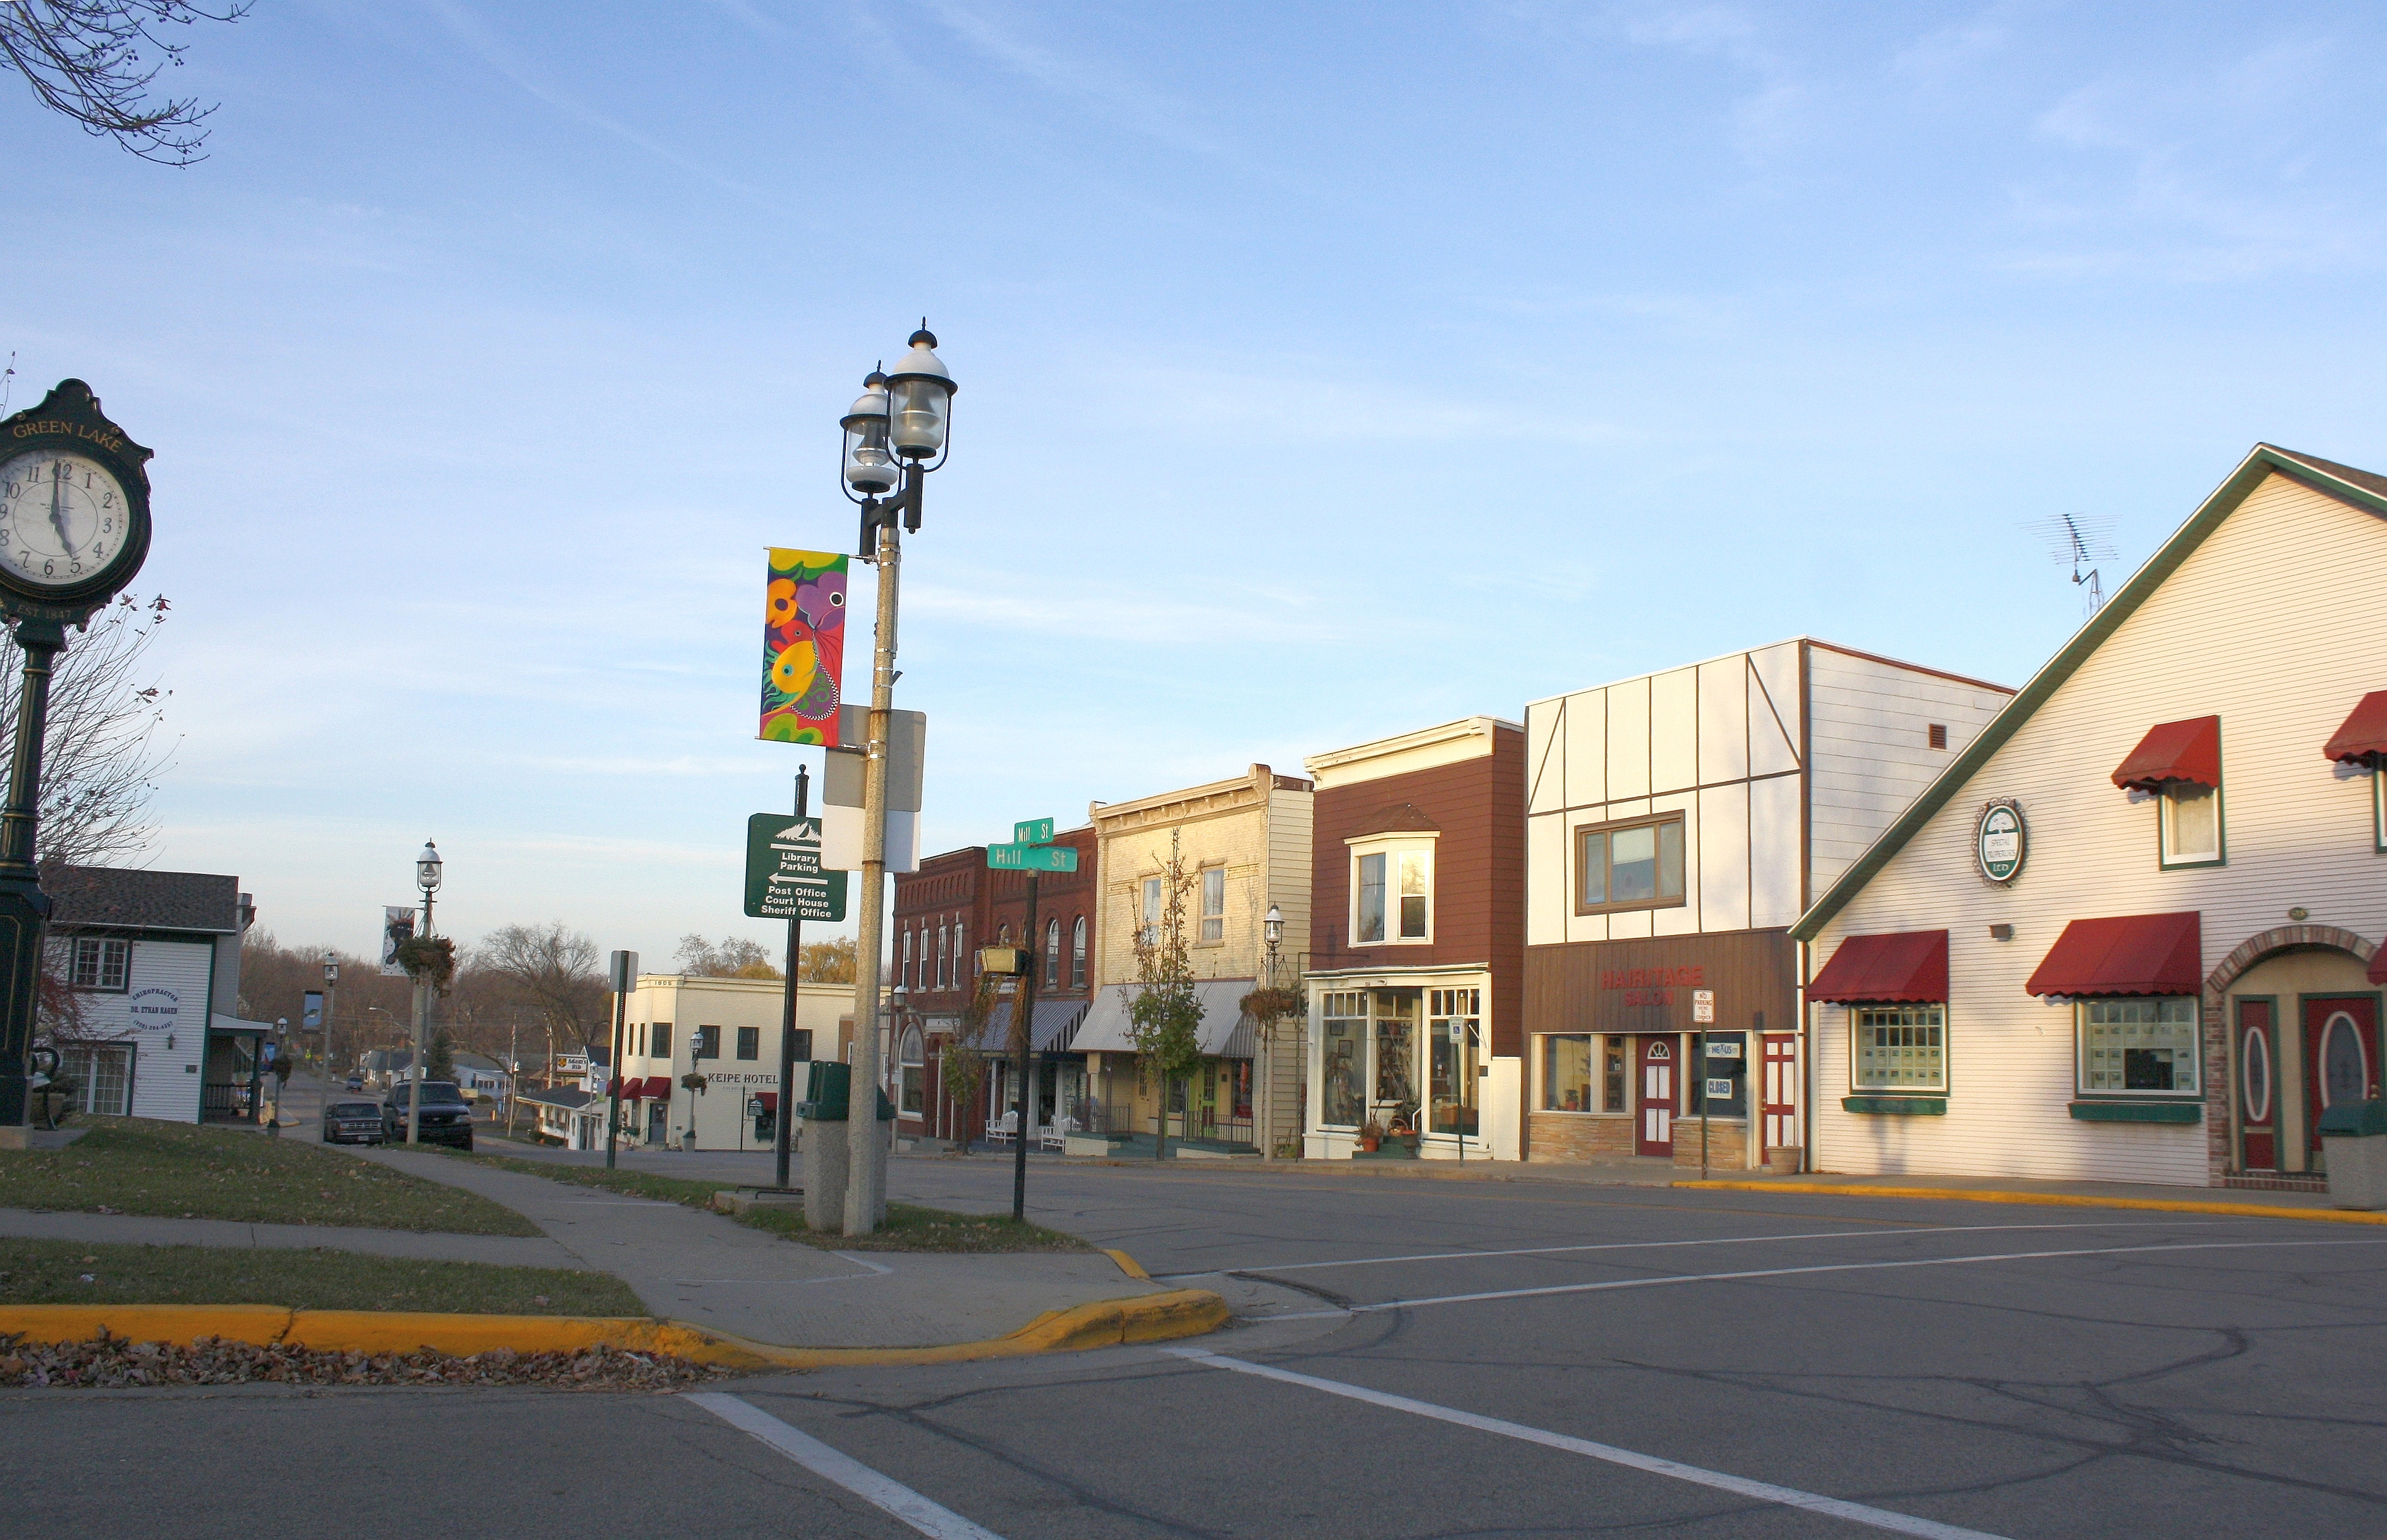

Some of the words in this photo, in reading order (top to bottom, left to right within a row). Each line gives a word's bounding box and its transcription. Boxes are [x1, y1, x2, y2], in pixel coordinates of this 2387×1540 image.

[13, 420, 73, 438] GREEN
[77, 424, 122, 453] LAKE
[27, 466, 40, 483] 11
[85, 472, 92, 489] 1
[3, 482, 20, 499] 10
[103, 492, 113, 508] 2
[103, 517, 112, 534] 3
[0, 529, 9, 546] 8
[93, 541, 104, 559] 4
[19, 550, 30, 568] 7
[44, 559, 54, 575] 6
[70, 555, 81, 573] 5
[1018, 826, 1030, 843] Mill
[1041, 823, 1048, 839] St
[782, 852, 817, 864] Library
[996, 848, 1021, 865] Hill
[1051, 851, 1066, 867] St
[780, 862, 819, 874] Parking
[768, 886, 791, 895] Post
[795, 888, 827, 898] Office
[765, 895, 794, 905] Court
[797, 898, 829, 908] House
[761, 905, 797, 915] Sheriff
[800, 908, 832, 918] Office
[1601, 965, 1704, 989] HAIRITAGE
[132, 988, 179, 1002] CHIROPRACTOR
[1624, 990, 1674, 1006] SALON
[708, 1073, 741, 1083] KEIPE
[744, 1074, 779, 1084] HOTEL
[1708, 1080, 1730, 1094] CLOSED
